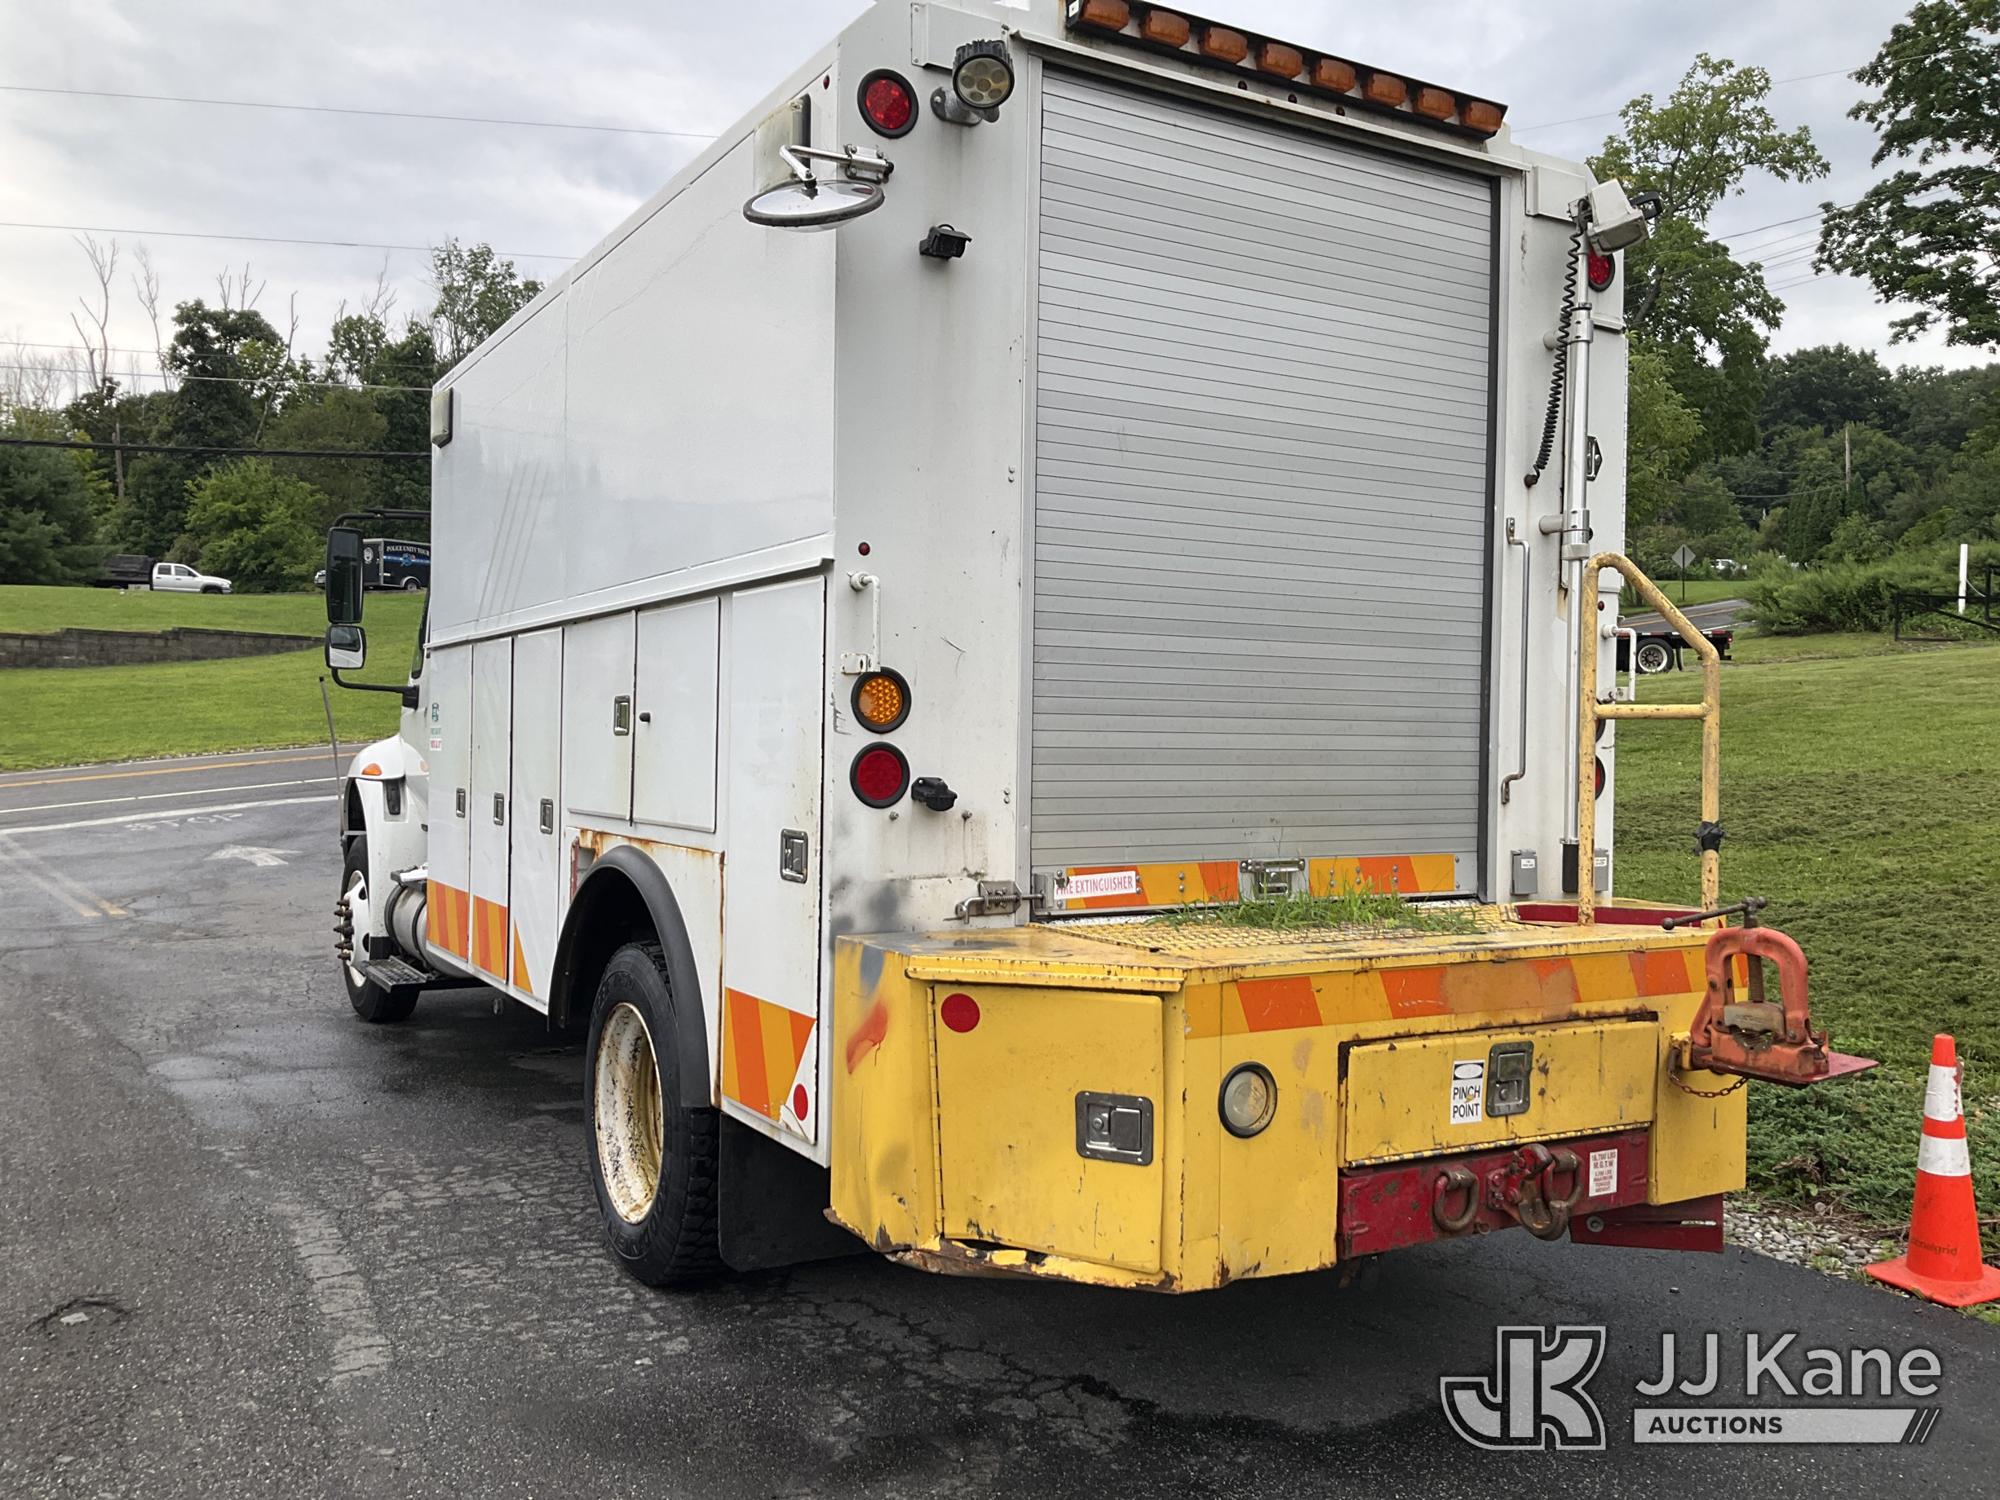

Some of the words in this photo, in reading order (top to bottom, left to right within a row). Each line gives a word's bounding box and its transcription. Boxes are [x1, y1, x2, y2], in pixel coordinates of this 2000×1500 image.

[403, 545, 417, 553] UNITY
[417, 547, 429, 556] TOUR
[1075, 875, 1133, 894] EXTINGUISHER
[1453, 1085, 1480, 1100] PINCH
[1452, 1103, 1480, 1118] POINT
